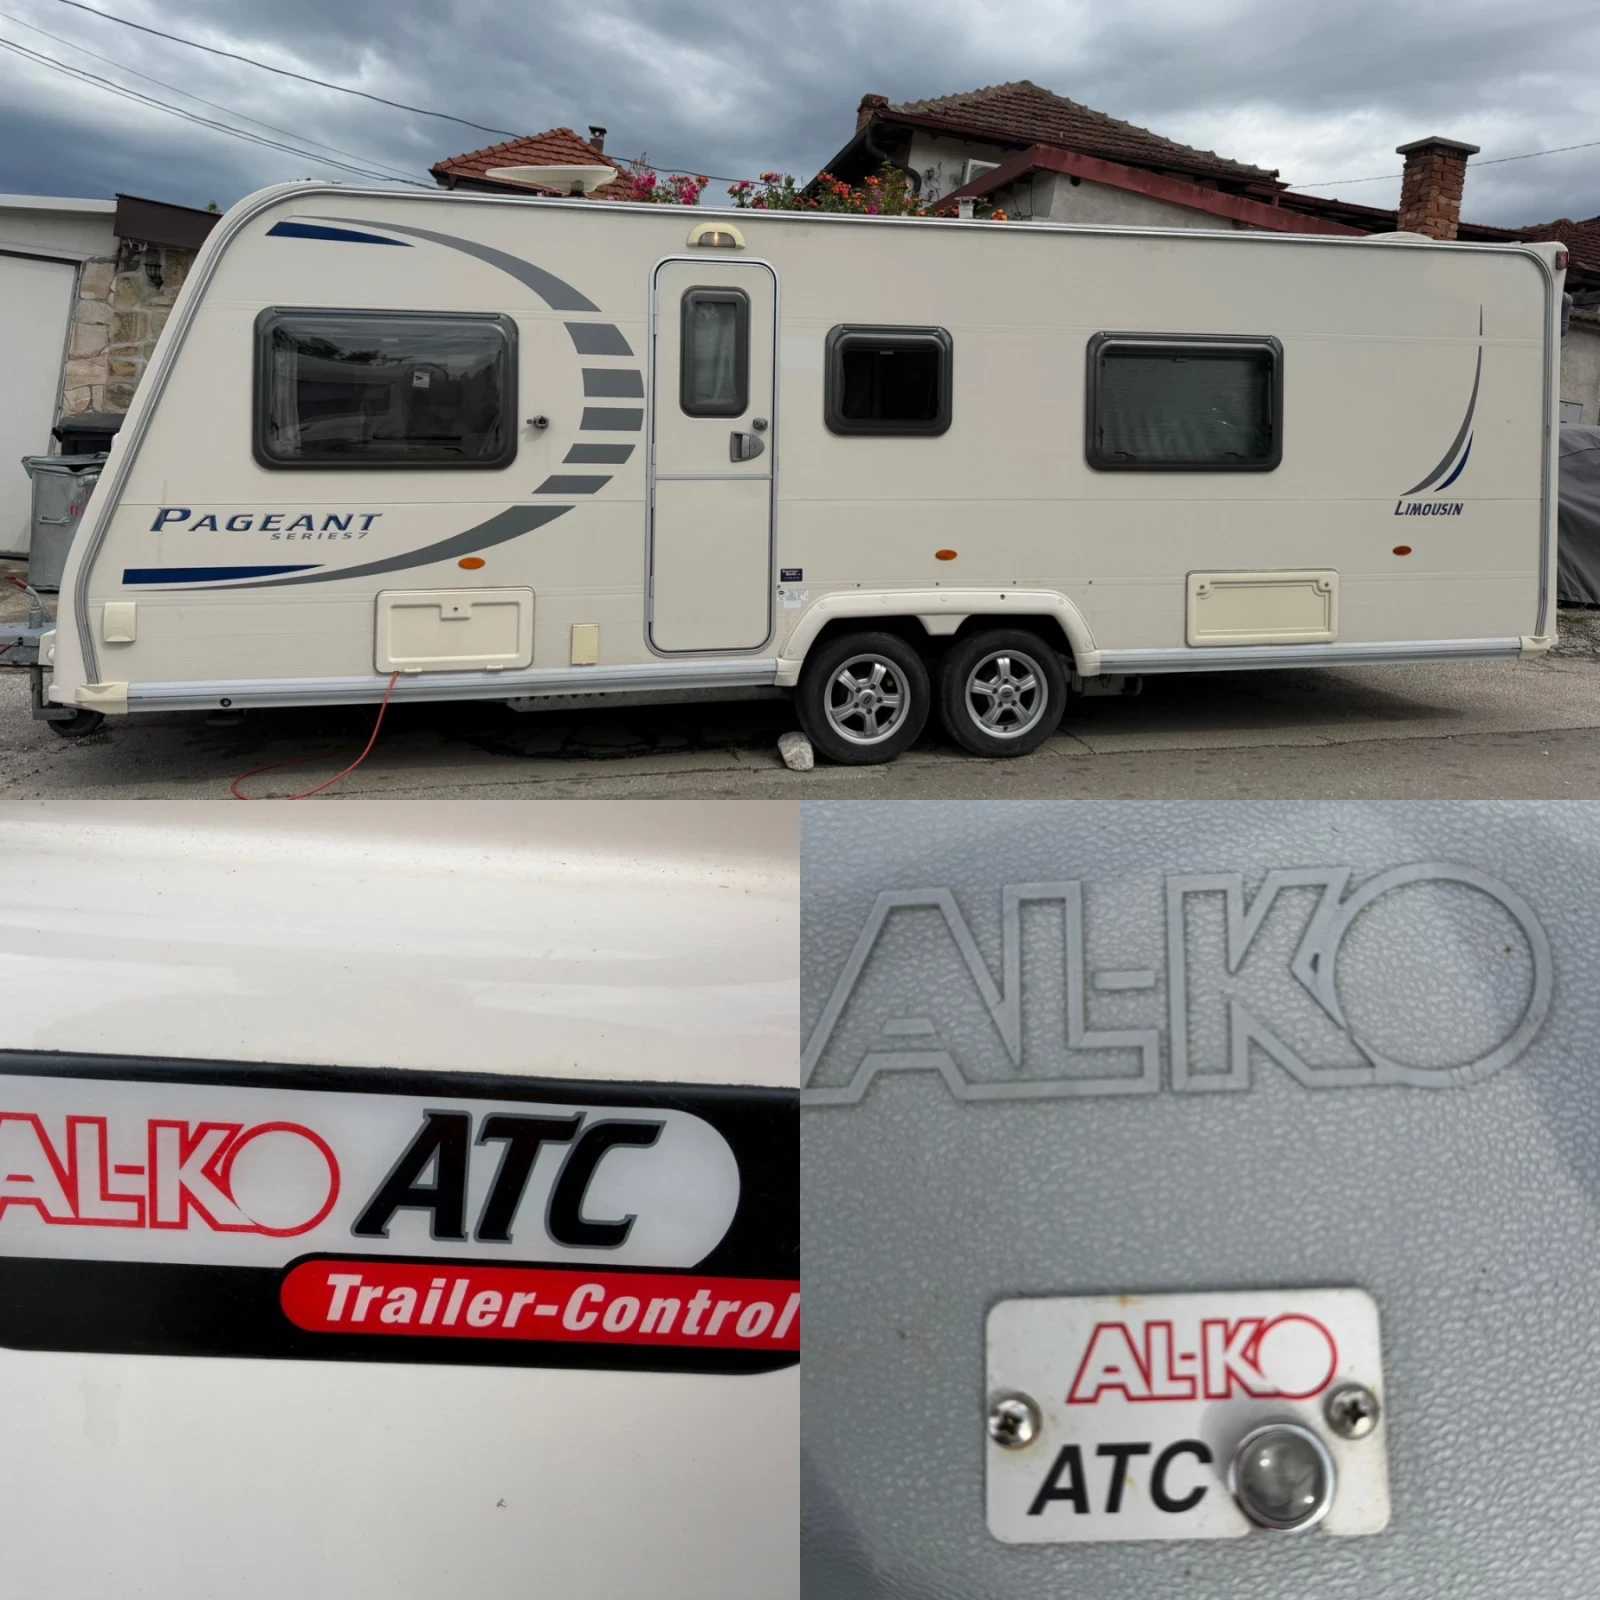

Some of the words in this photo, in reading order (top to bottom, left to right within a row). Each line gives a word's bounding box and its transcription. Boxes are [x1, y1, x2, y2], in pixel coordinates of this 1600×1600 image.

[150, 506, 383, 532] PAGEANT
[1394, 500, 1464, 516] LIMOUSIN
[799, 861, 1554, 1104] AL-KO
[0, 1111, 341, 1237] AL-KO
[350, 1108, 666, 1250] ATC
[326, 1274, 800, 1339] Trailer-Control
[1066, 1313, 1338, 1405] AL-KO
[1027, 1438, 1213, 1516] ATC
